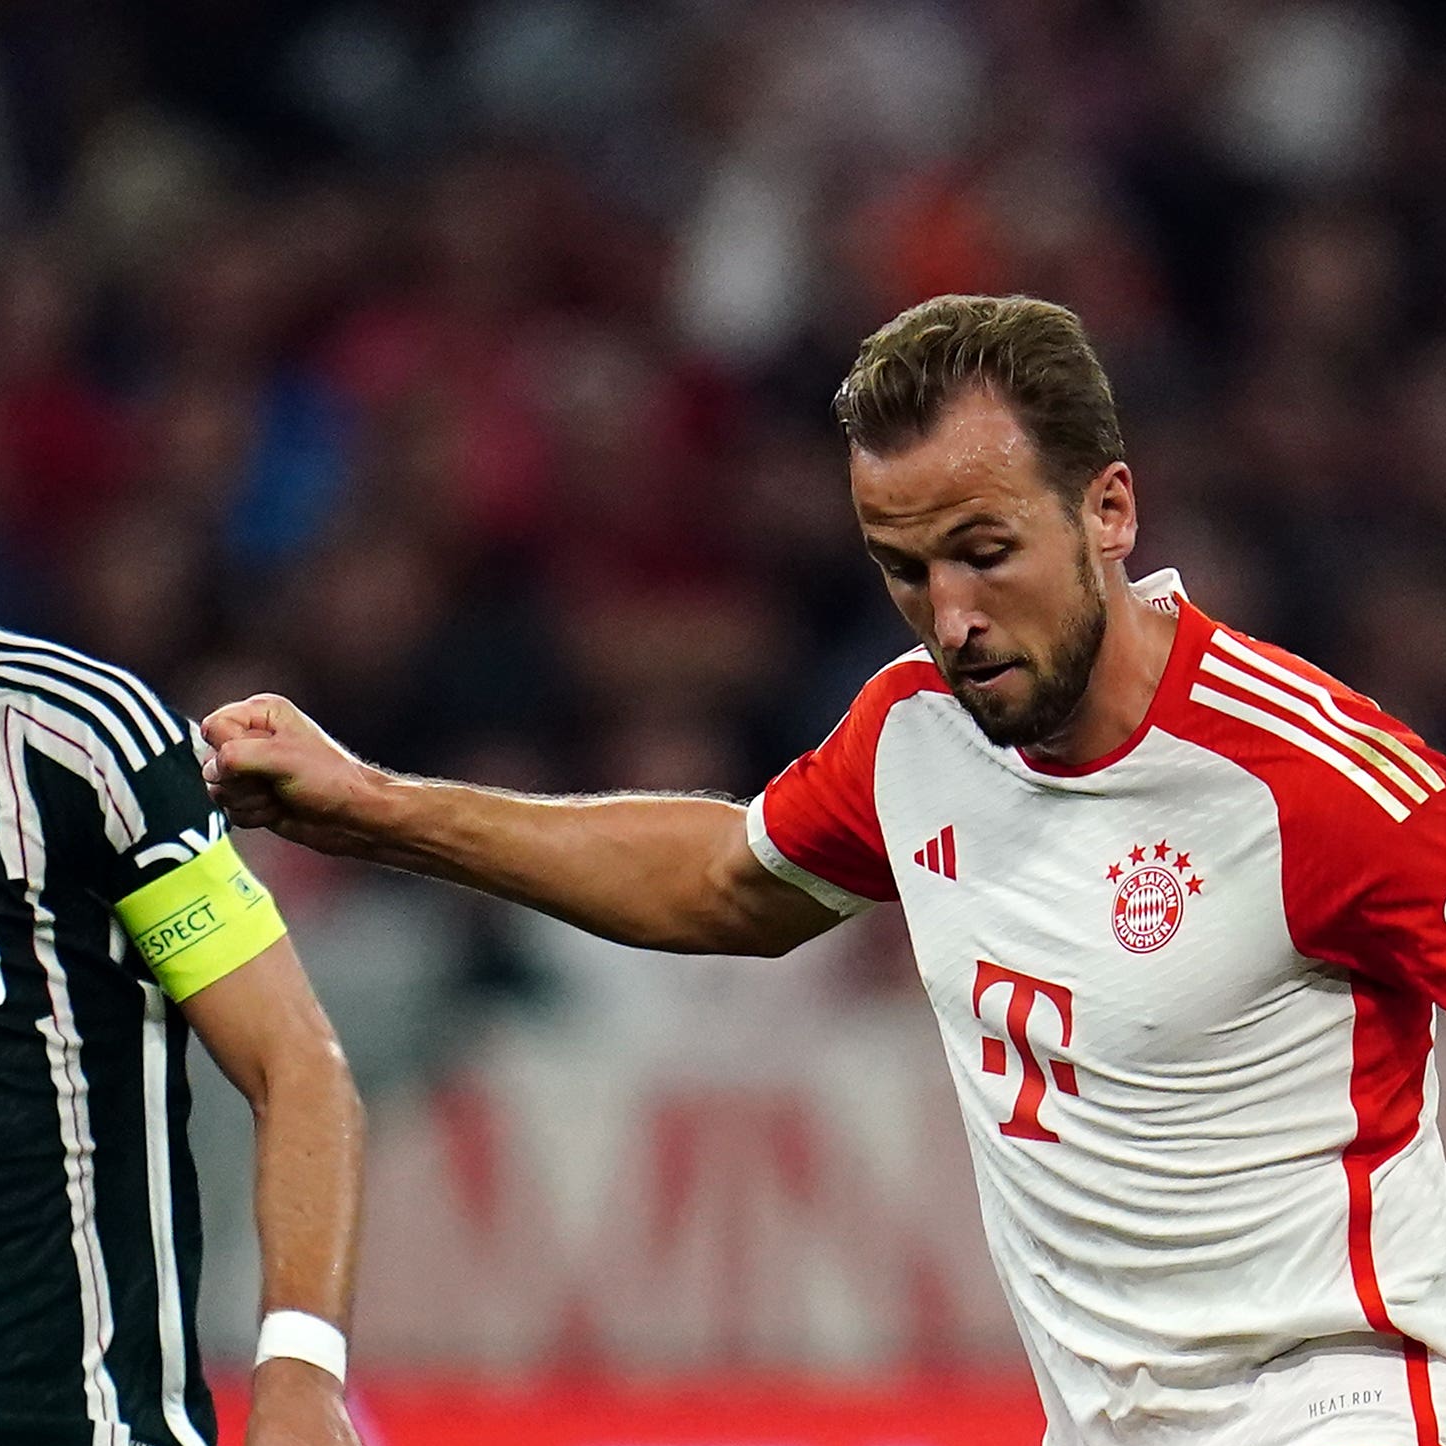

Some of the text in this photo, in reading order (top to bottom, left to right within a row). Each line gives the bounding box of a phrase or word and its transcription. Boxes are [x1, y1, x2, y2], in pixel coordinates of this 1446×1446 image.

[1120, 872, 1177, 908] FC BAYERN
[140, 902, 217, 962] ESPECT
[972, 959, 1080, 1144] T
